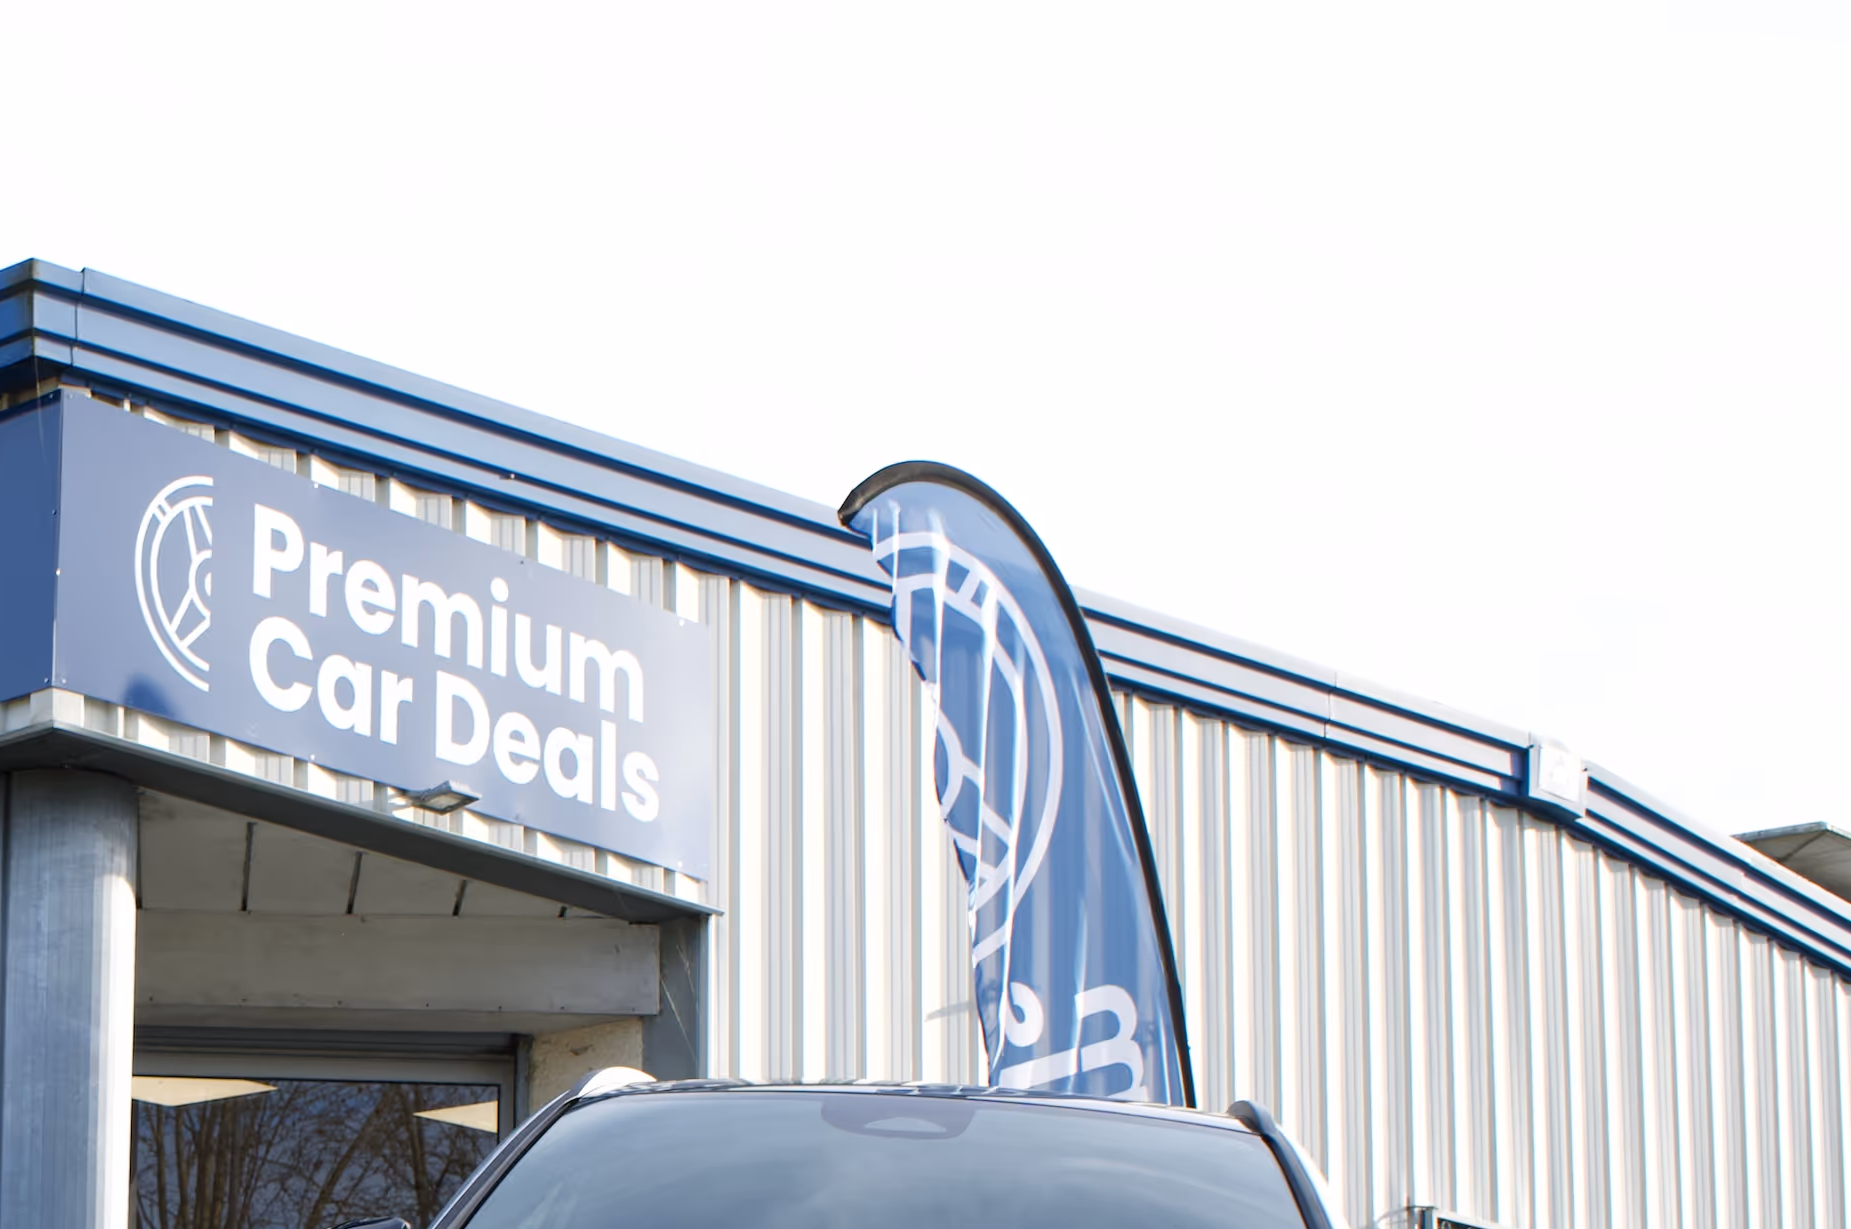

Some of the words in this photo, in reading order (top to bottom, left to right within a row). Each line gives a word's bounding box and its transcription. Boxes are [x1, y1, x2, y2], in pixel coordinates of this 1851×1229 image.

[249, 615, 414, 745] Car
[434, 669, 660, 823] Deals
[252, 503, 644, 724] Premium
